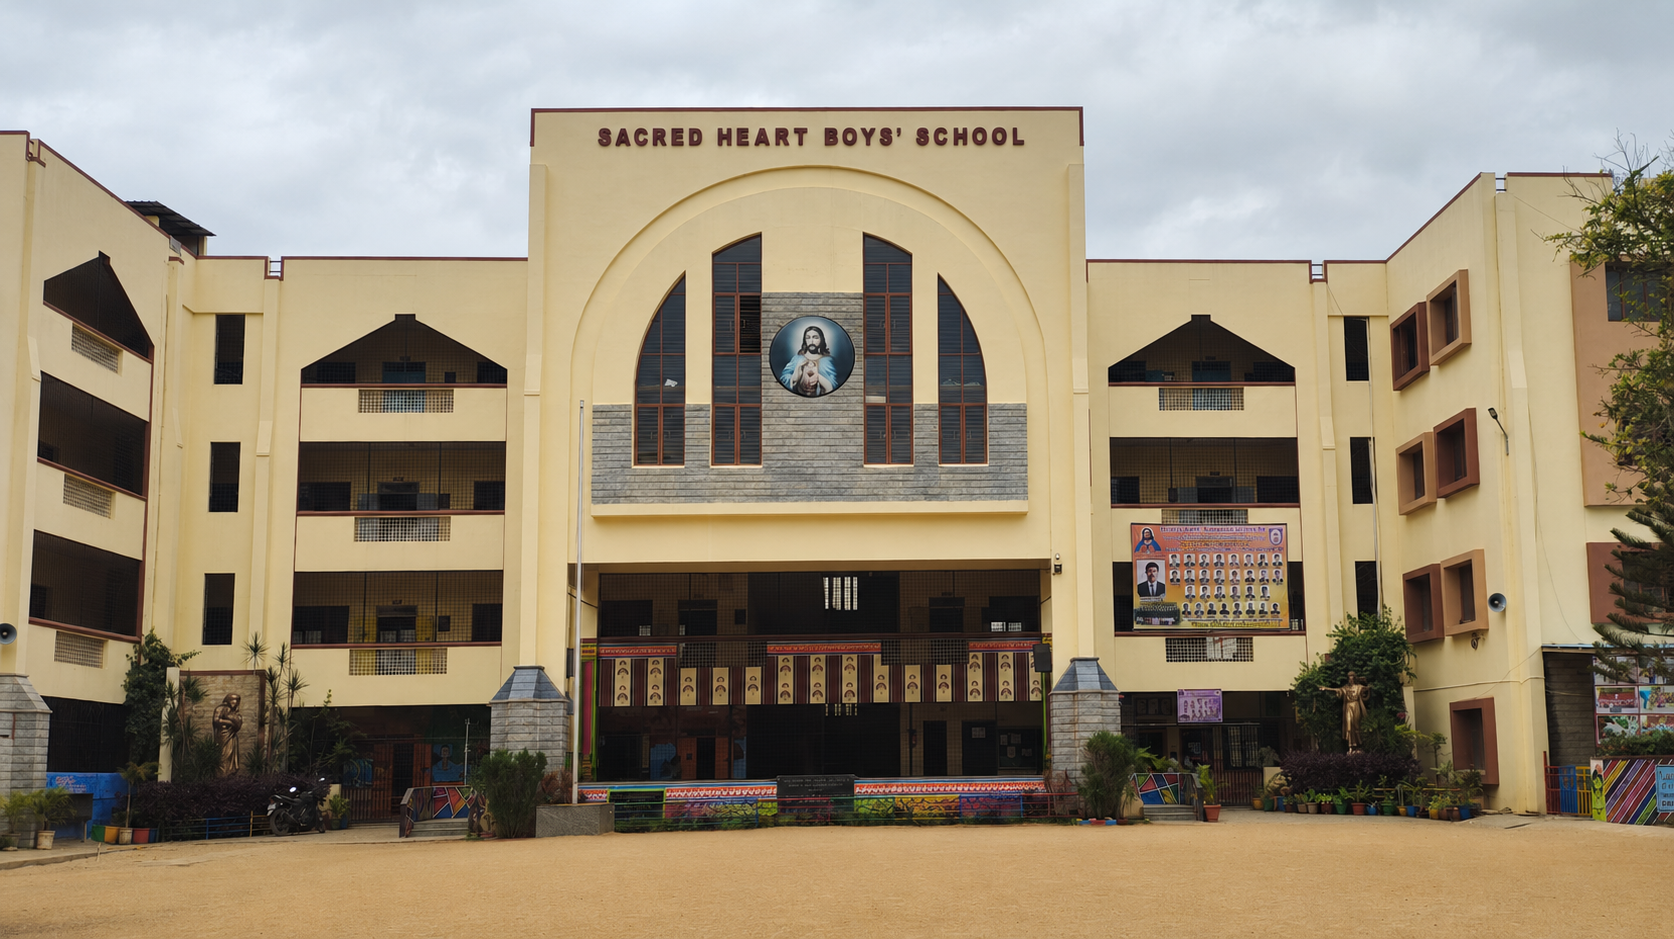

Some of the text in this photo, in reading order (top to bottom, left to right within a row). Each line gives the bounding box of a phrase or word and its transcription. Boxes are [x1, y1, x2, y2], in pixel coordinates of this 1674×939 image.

[597, 127, 703, 147] SACRED
[717, 127, 808, 147] HEART
[915, 126, 1025, 147] SCHOOL
